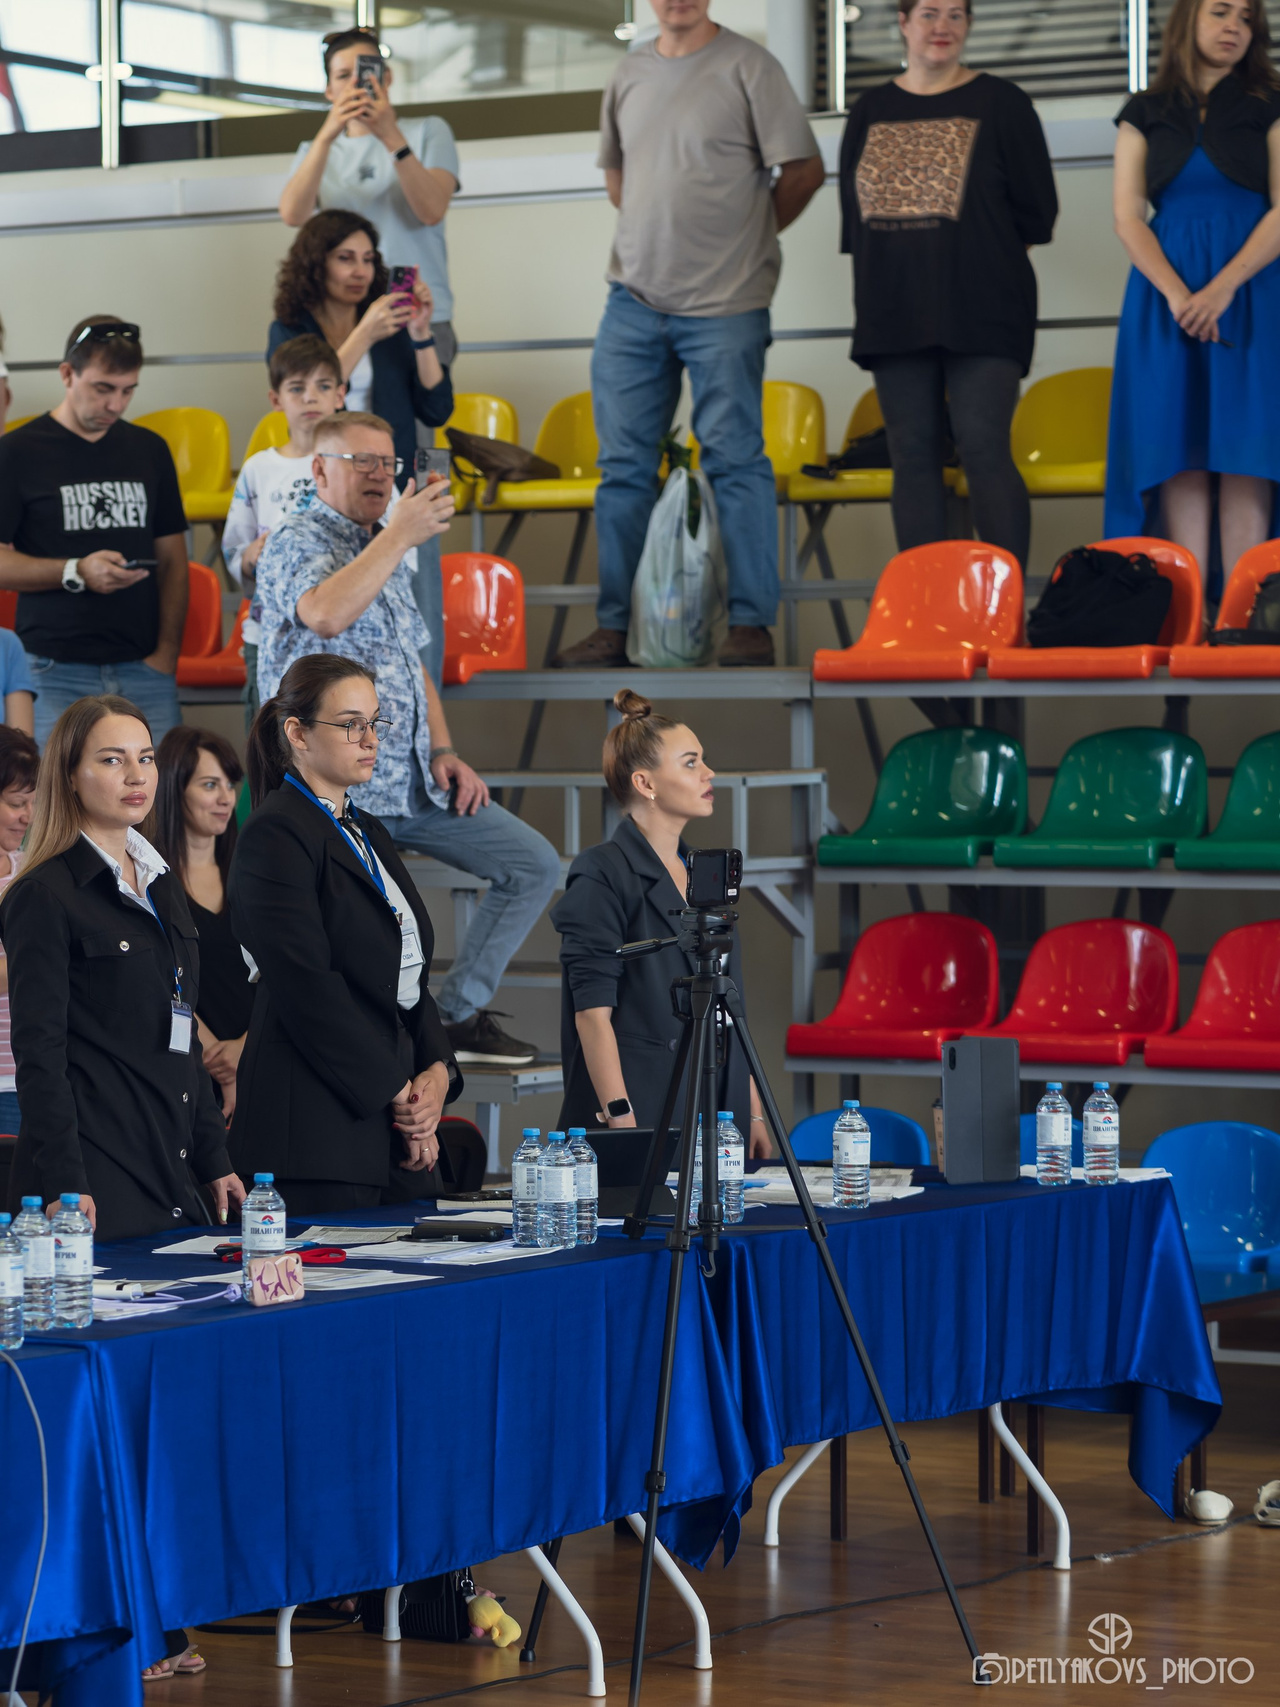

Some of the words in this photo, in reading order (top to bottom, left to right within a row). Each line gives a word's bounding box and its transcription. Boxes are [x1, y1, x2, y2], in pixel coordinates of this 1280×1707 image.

[60, 481, 147, 505] RUSSIAN
[63, 502, 147, 531] HOCKEY
[250, 1226, 285, 1235] ПИЛИГРИМ
